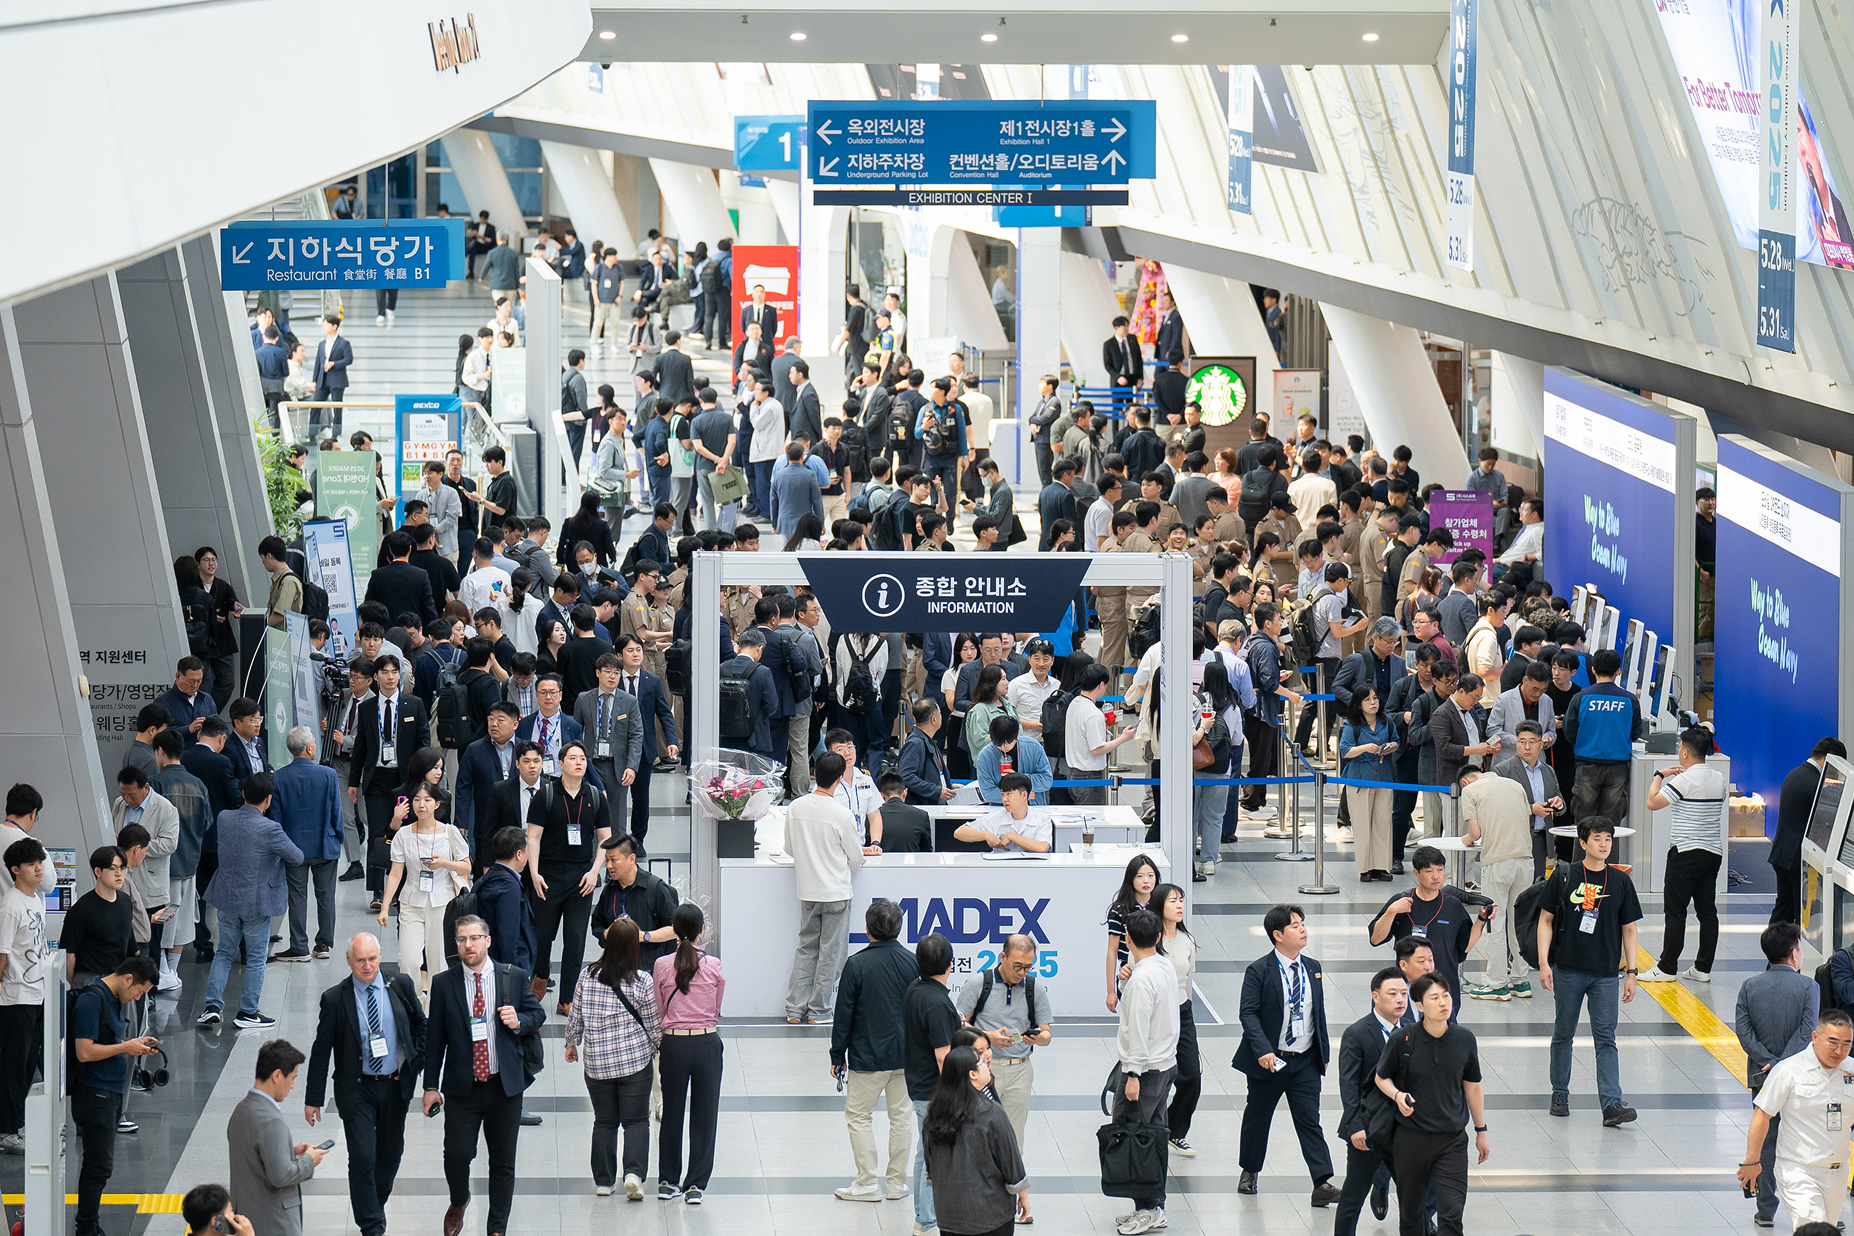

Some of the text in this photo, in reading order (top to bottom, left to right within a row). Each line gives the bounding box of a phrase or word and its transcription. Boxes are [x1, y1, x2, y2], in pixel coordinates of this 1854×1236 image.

[1454, 15, 1466, 157] 2025
[1683, 76, 1703, 107] For
[1697, 78, 1730, 111] Better
[847, 118, 926, 136] 옥외전시장
[999, 119, 1096, 137] 제1전시장1홀
[1769, 40, 1783, 210] 2025
[779, 131, 791, 162] 1
[846, 137, 925, 145] Outdoor Exhibition Area
[847, 152, 926, 171] 지하주차장
[949, 153, 1100, 172] 컨벤션홀/오디토리움
[846, 171, 890, 179] Underground
[891, 171, 917, 179] Parking
[909, 192, 973, 204] EXHIBITION
[976, 192, 1024, 204] CENTER
[267, 235, 434, 267] 지하식당가
[267, 268, 338, 281] Restaurant
[343, 268, 377, 281] 食堂街
[415, 268, 431, 280] B1
[1444, 518, 1478, 528] 참가업체
[1584, 494, 1620, 537] Way to Blue
[1462, 529, 1487, 539] 수령처
[1591, 533, 1628, 585] Ocean Navy
[915, 576, 1027, 598] 종합 안내소
[927, 601, 1015, 613] INFORMATION
[1750, 577, 1790, 629] Way to Blue
[95, 650, 147, 664] 지원센터
[1758, 622, 1799, 684] Ocean Navy
[117, 703, 137, 711] Shops
[1588, 700, 1626, 712] STAFF
[97, 734, 124, 743] ding Hall
[976, 949, 1059, 979] 25
